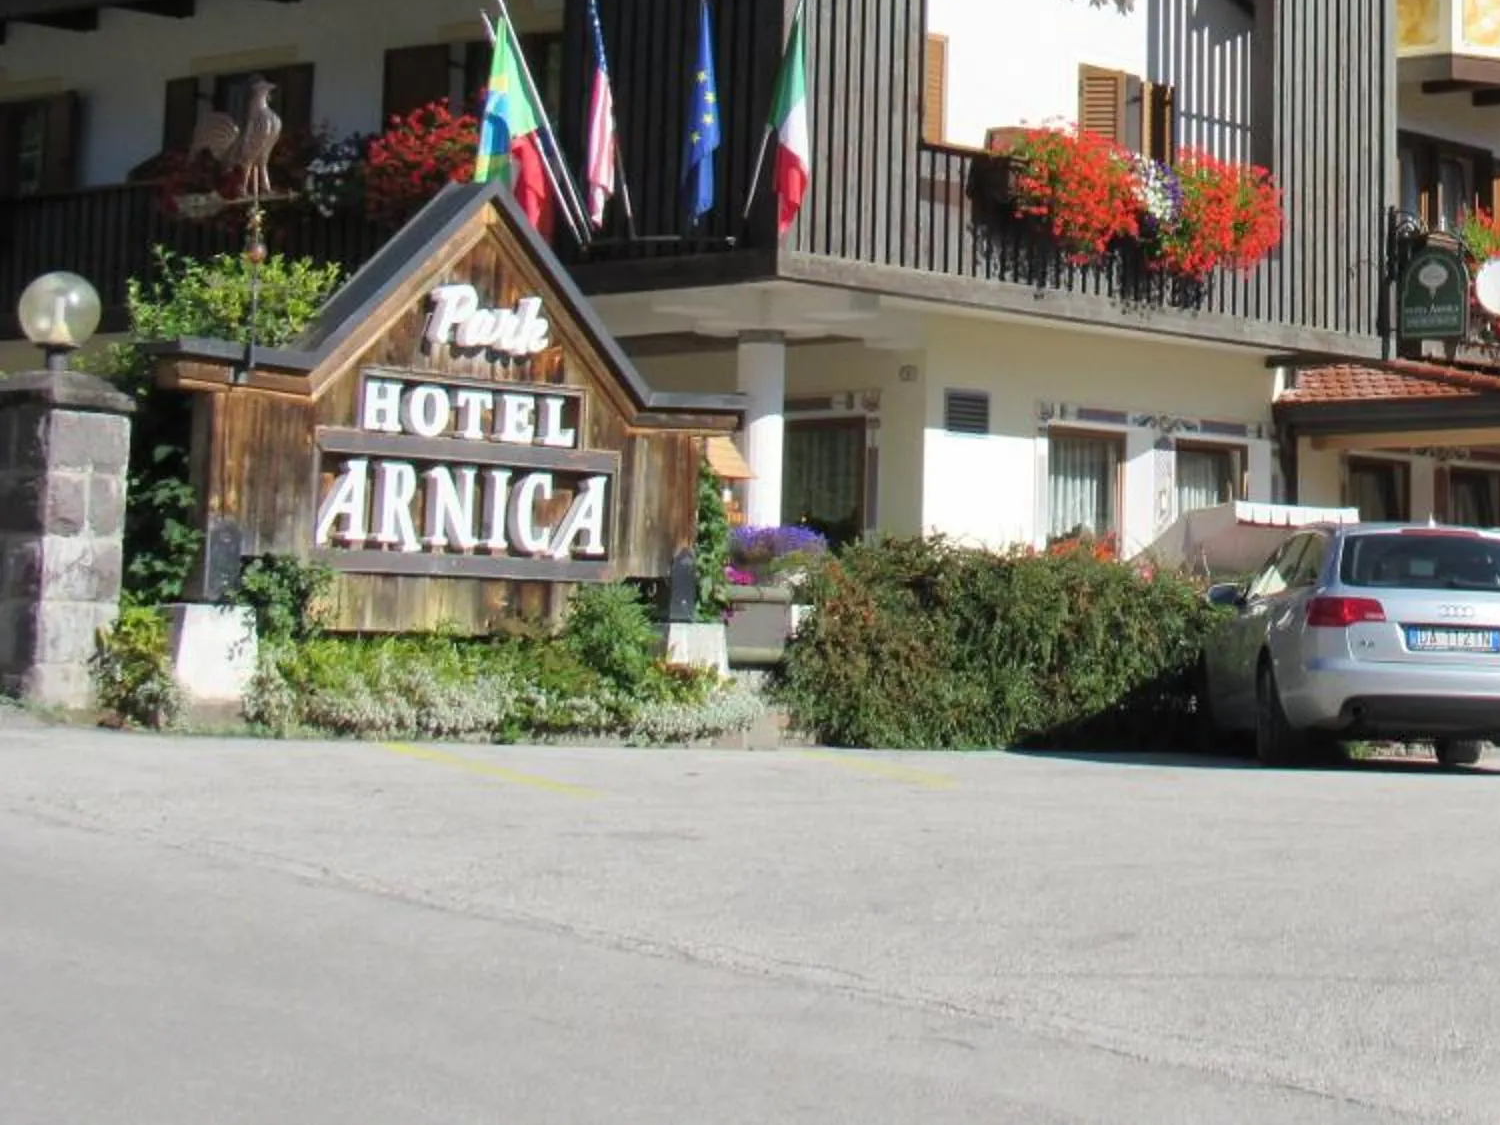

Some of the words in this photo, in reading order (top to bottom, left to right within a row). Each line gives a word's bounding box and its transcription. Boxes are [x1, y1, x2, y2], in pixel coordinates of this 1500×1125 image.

[427, 283, 549, 357] Park
[363, 377, 577, 448] HOTEL
[315, 457, 609, 560] ARNICA
